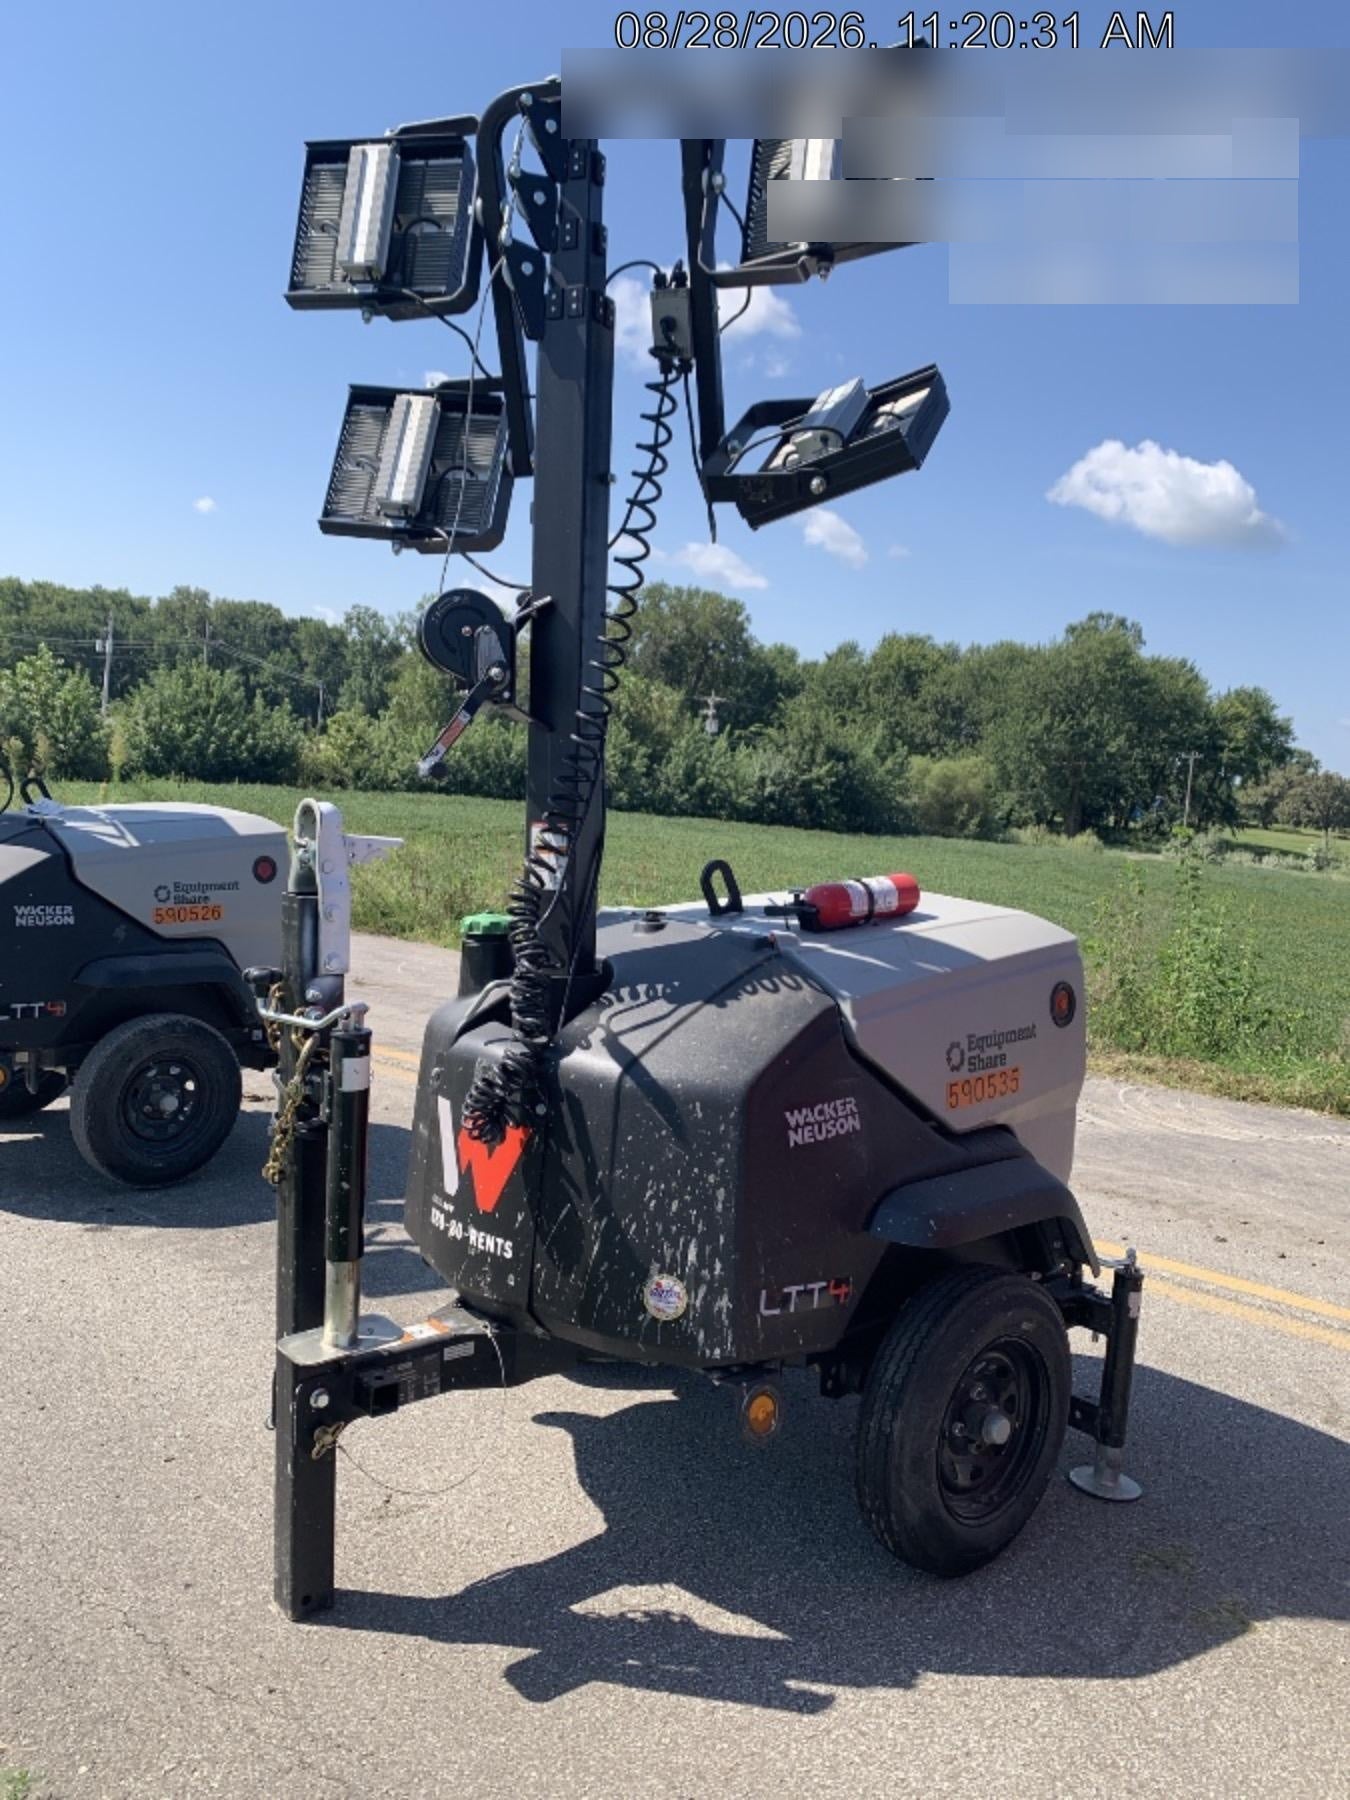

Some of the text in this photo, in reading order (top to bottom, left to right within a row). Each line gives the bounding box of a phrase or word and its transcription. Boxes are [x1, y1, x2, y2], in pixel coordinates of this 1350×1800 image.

[173, 881, 240, 894] Equipment
[13, 905, 73, 915] WACKER
[173, 895, 211, 905] Share
[15, 915, 75, 927] NEUSON
[154, 905, 222, 925] 590526
[966, 1022, 1037, 1053] Equipment
[967, 1053, 1007, 1073] Share
[948, 1067, 1019, 1109] 590535
[784, 1096, 858, 1129] WACKER
[787, 1113, 861, 1148] NEUSON
[760, 1279, 849, 1317] LTT4
